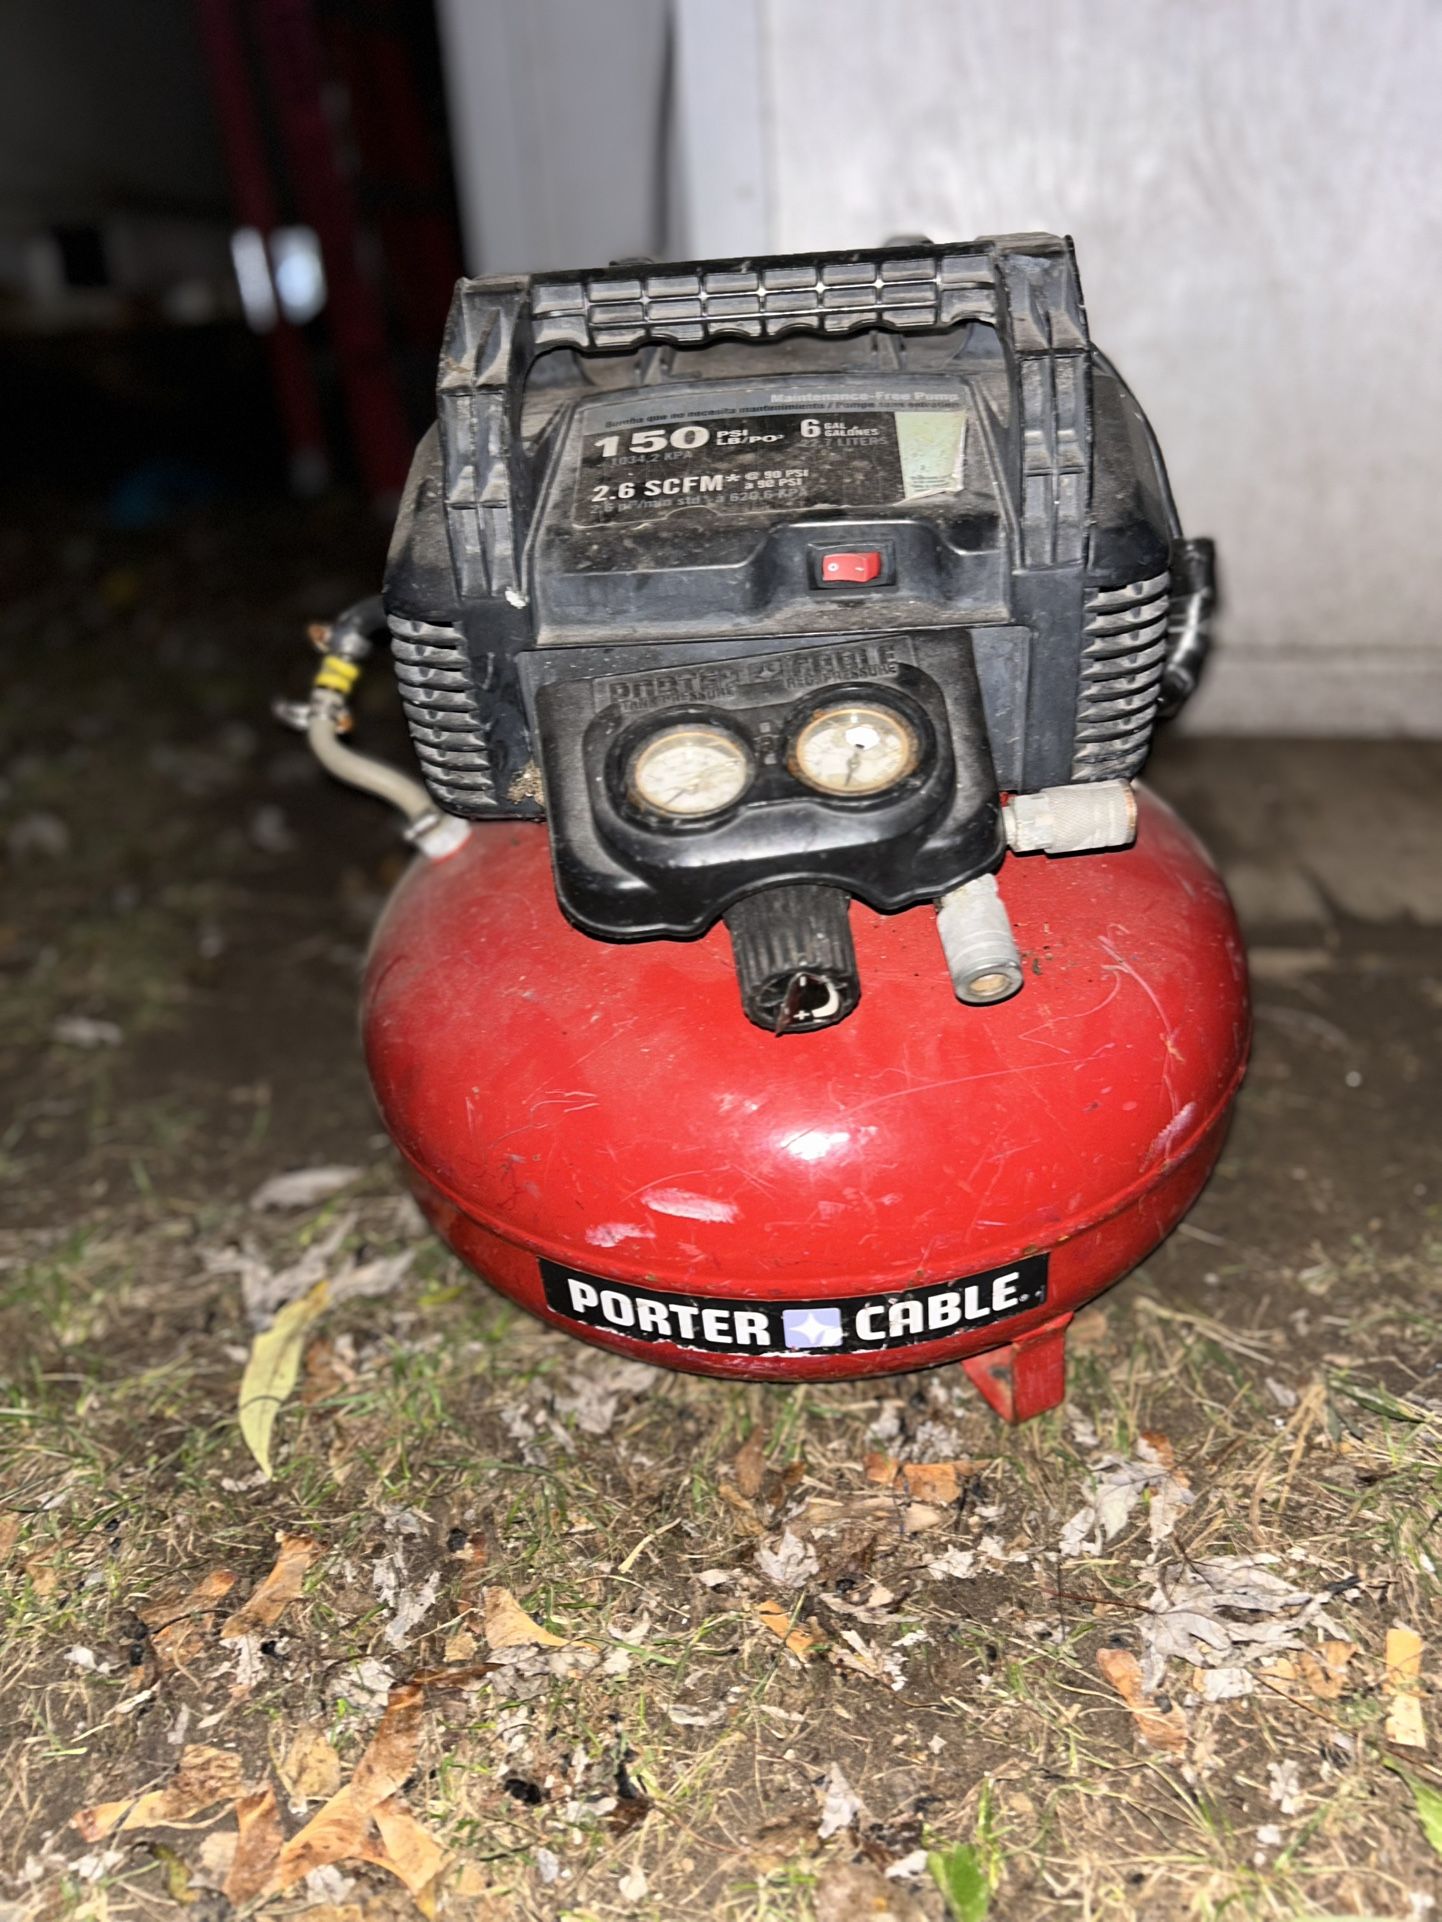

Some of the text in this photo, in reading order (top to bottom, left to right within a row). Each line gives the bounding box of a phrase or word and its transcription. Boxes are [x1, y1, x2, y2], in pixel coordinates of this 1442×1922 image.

[914, 391, 960, 402] Pump
[801, 419, 821, 438] 6
[824, 422, 847, 430] GAL
[716, 429, 749, 438] PSI
[594, 426, 710, 457] 150
[837, 437, 888, 447] LITERS
[611, 451, 693, 466] 1034.2 KPA
[764, 470, 783, 479] 90
[786, 469, 809, 477] PSI
[757, 479, 775, 488] 90
[778, 478, 802, 486] PSI
[592, 482, 635, 502] 2.6
[568, 1278, 771, 1346] PORTER
